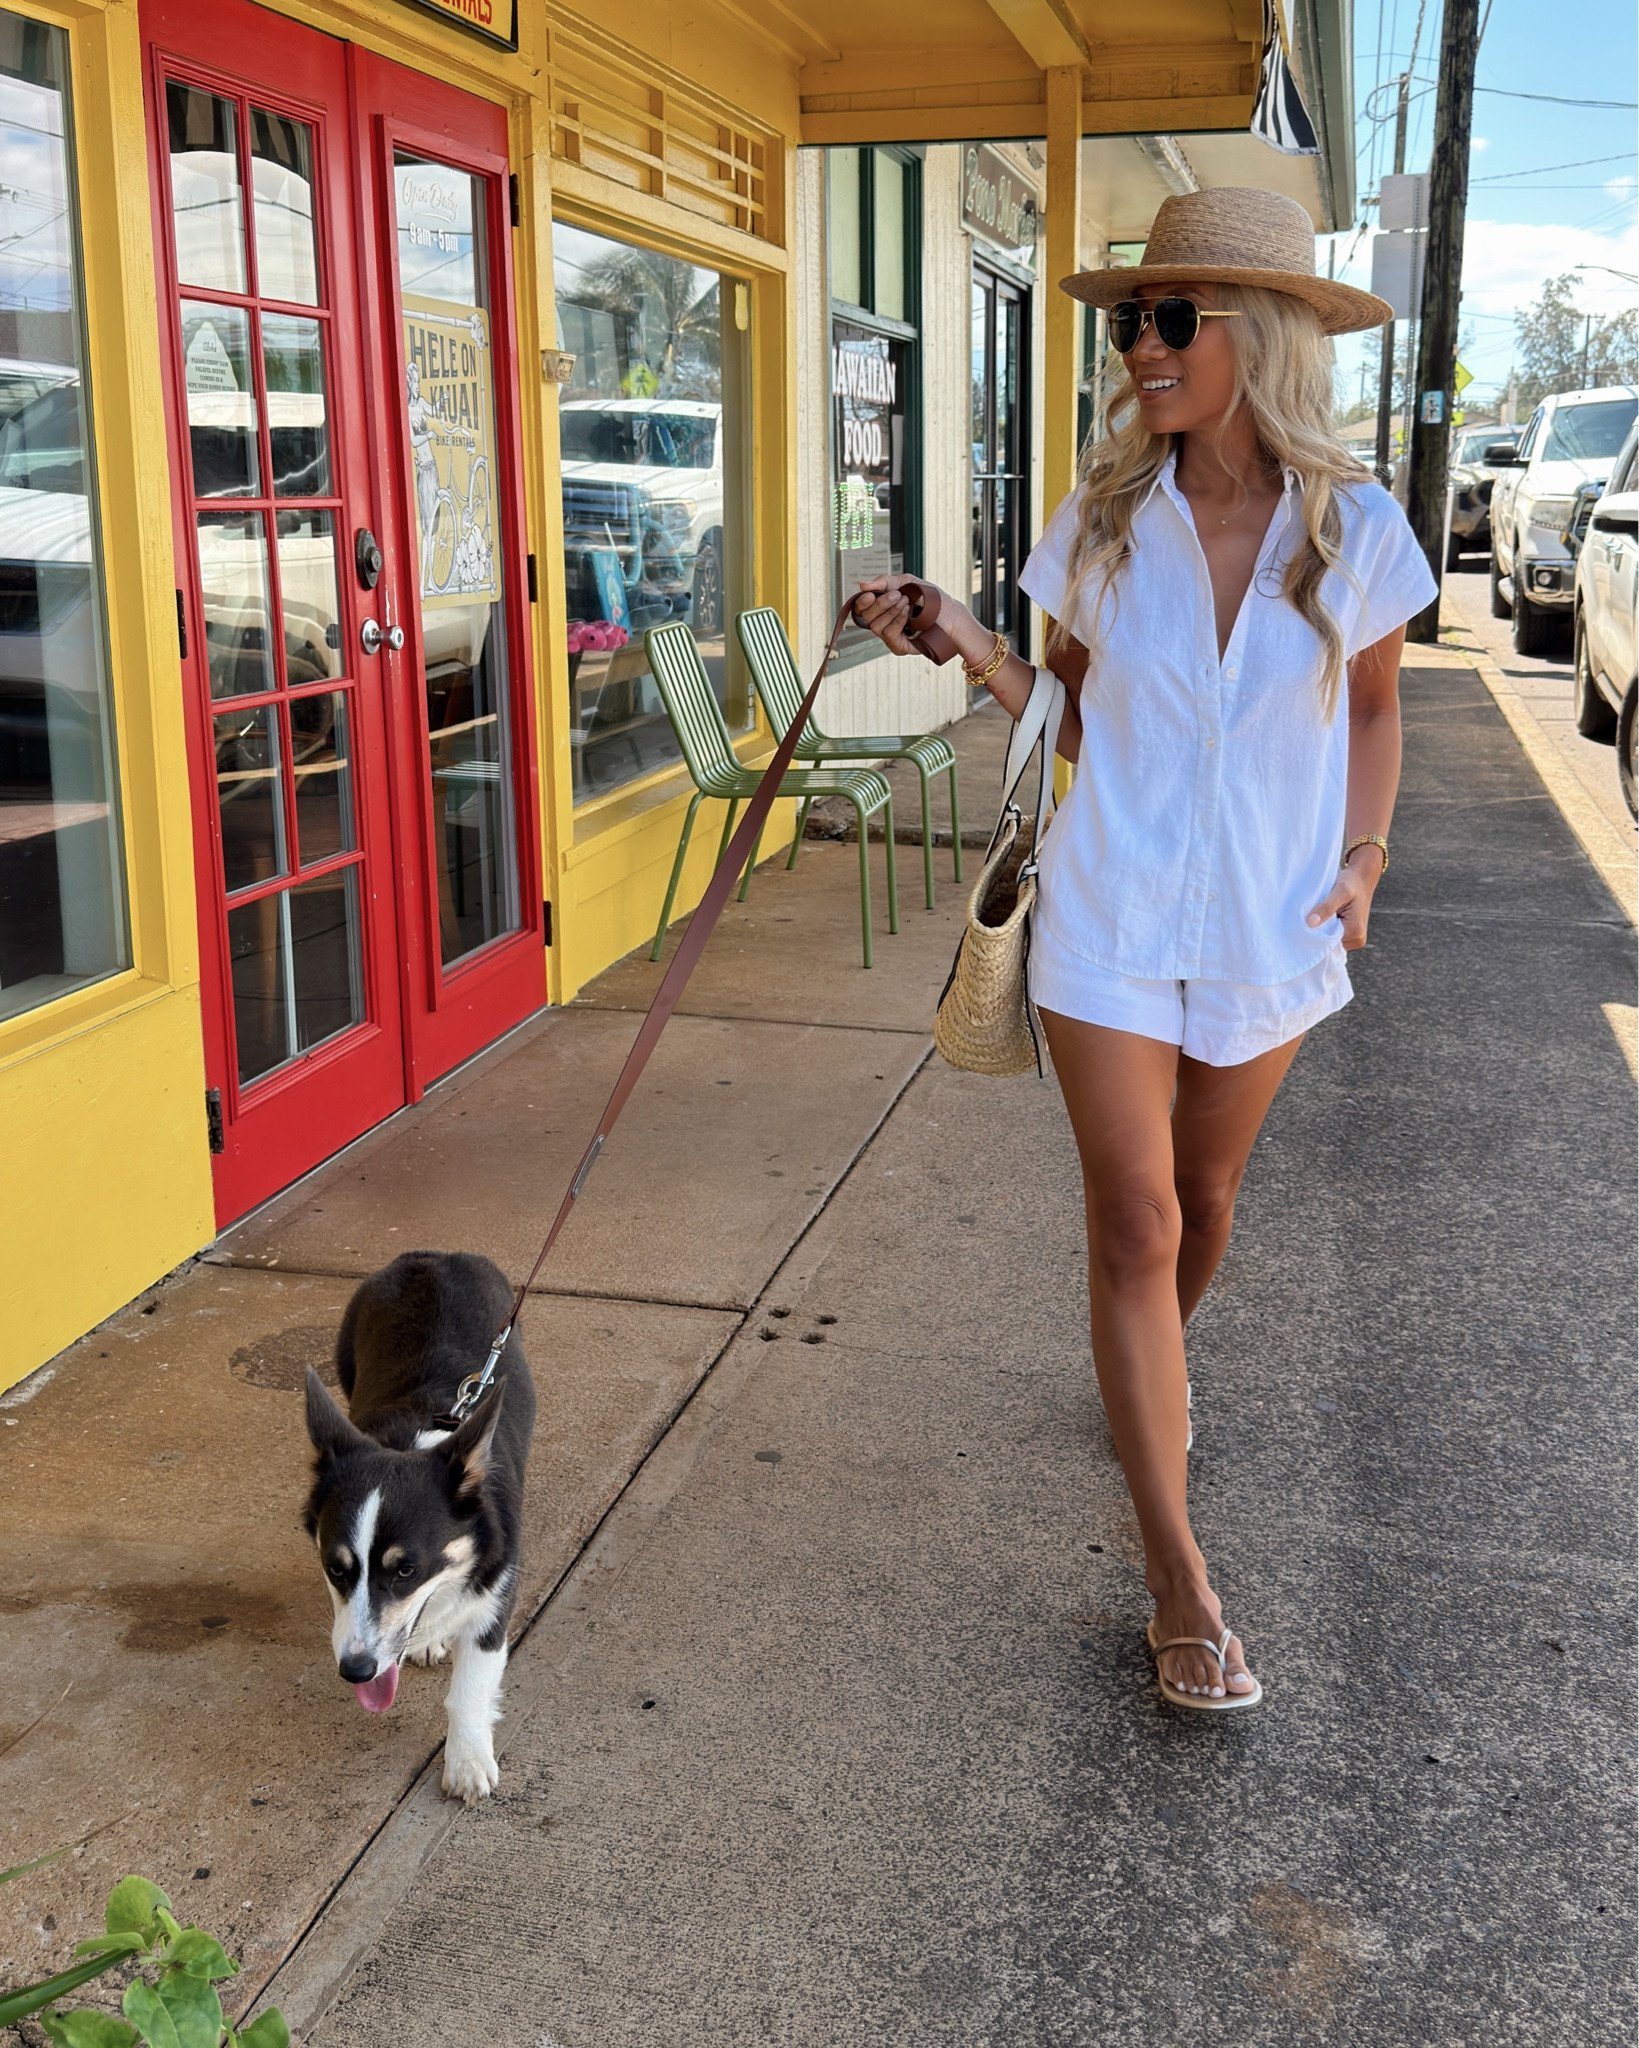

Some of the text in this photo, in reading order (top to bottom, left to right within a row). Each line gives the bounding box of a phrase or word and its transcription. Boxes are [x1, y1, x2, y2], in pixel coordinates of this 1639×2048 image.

[402, 176, 428, 210] Open
[965, 148, 996, 227] Pono
[408, 324, 476, 379] HELE ON
[430, 382, 479, 430] KAUAI
[435, 434, 475, 448] BIKE RENTALS
[843, 420, 882, 467] FOOD
